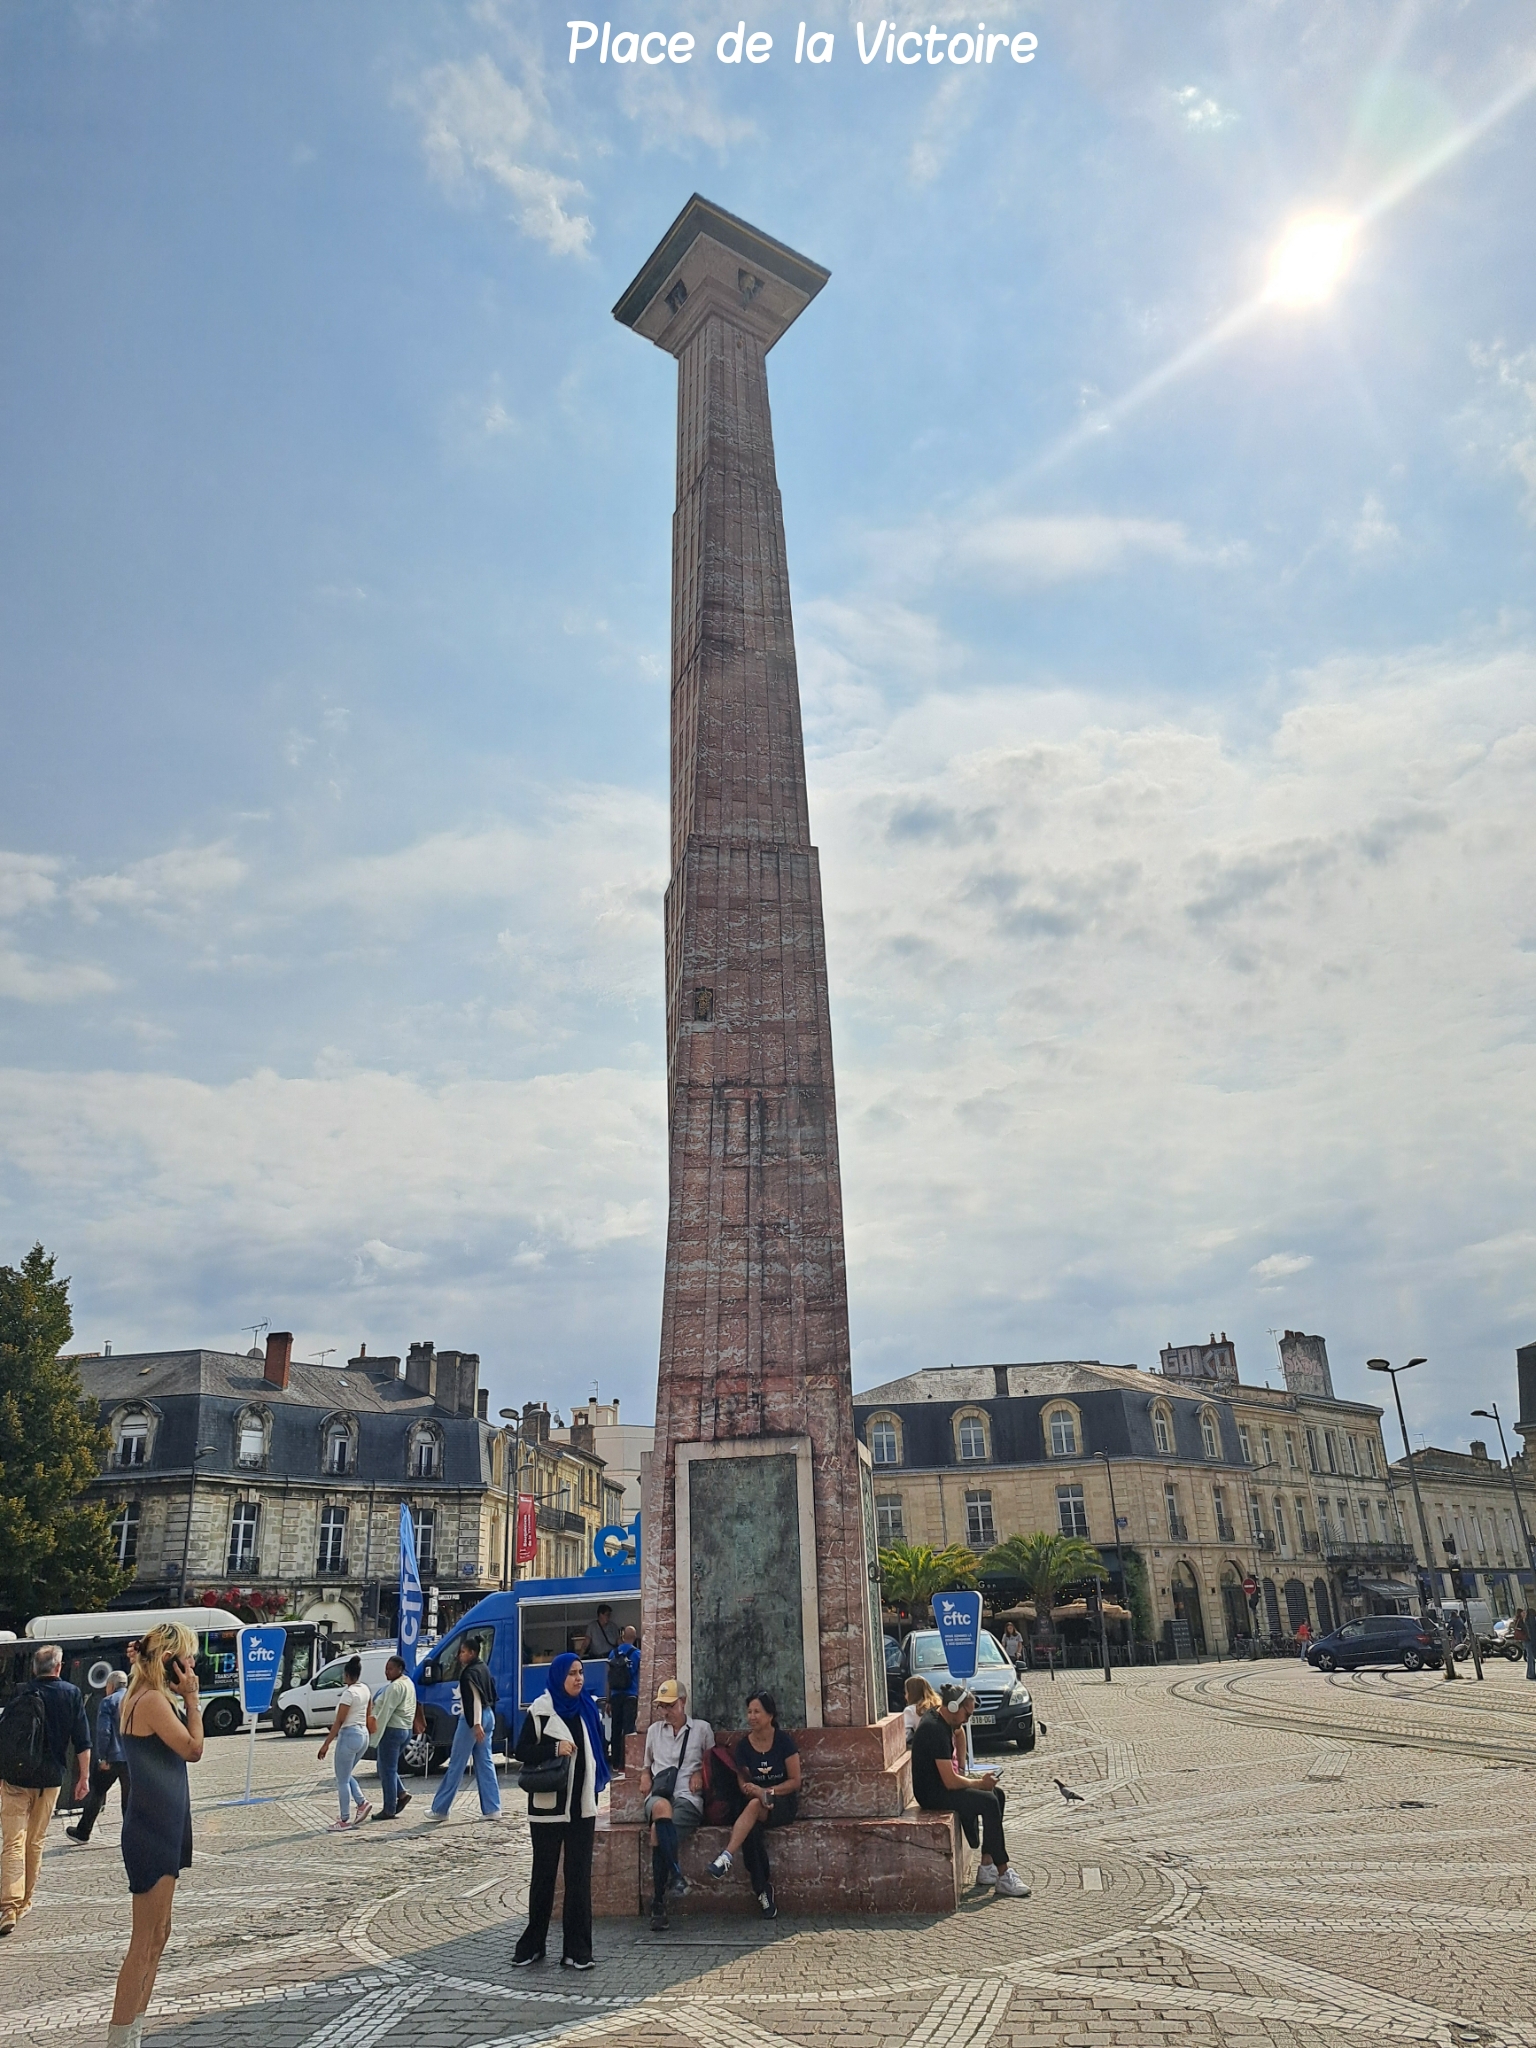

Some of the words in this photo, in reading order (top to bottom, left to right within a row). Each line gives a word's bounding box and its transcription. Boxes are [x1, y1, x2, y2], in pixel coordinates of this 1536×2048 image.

[943, 1611, 971, 1626] cftc
[248, 1647, 275, 1662] cftc
[207, 1652, 239, 1673] TB
